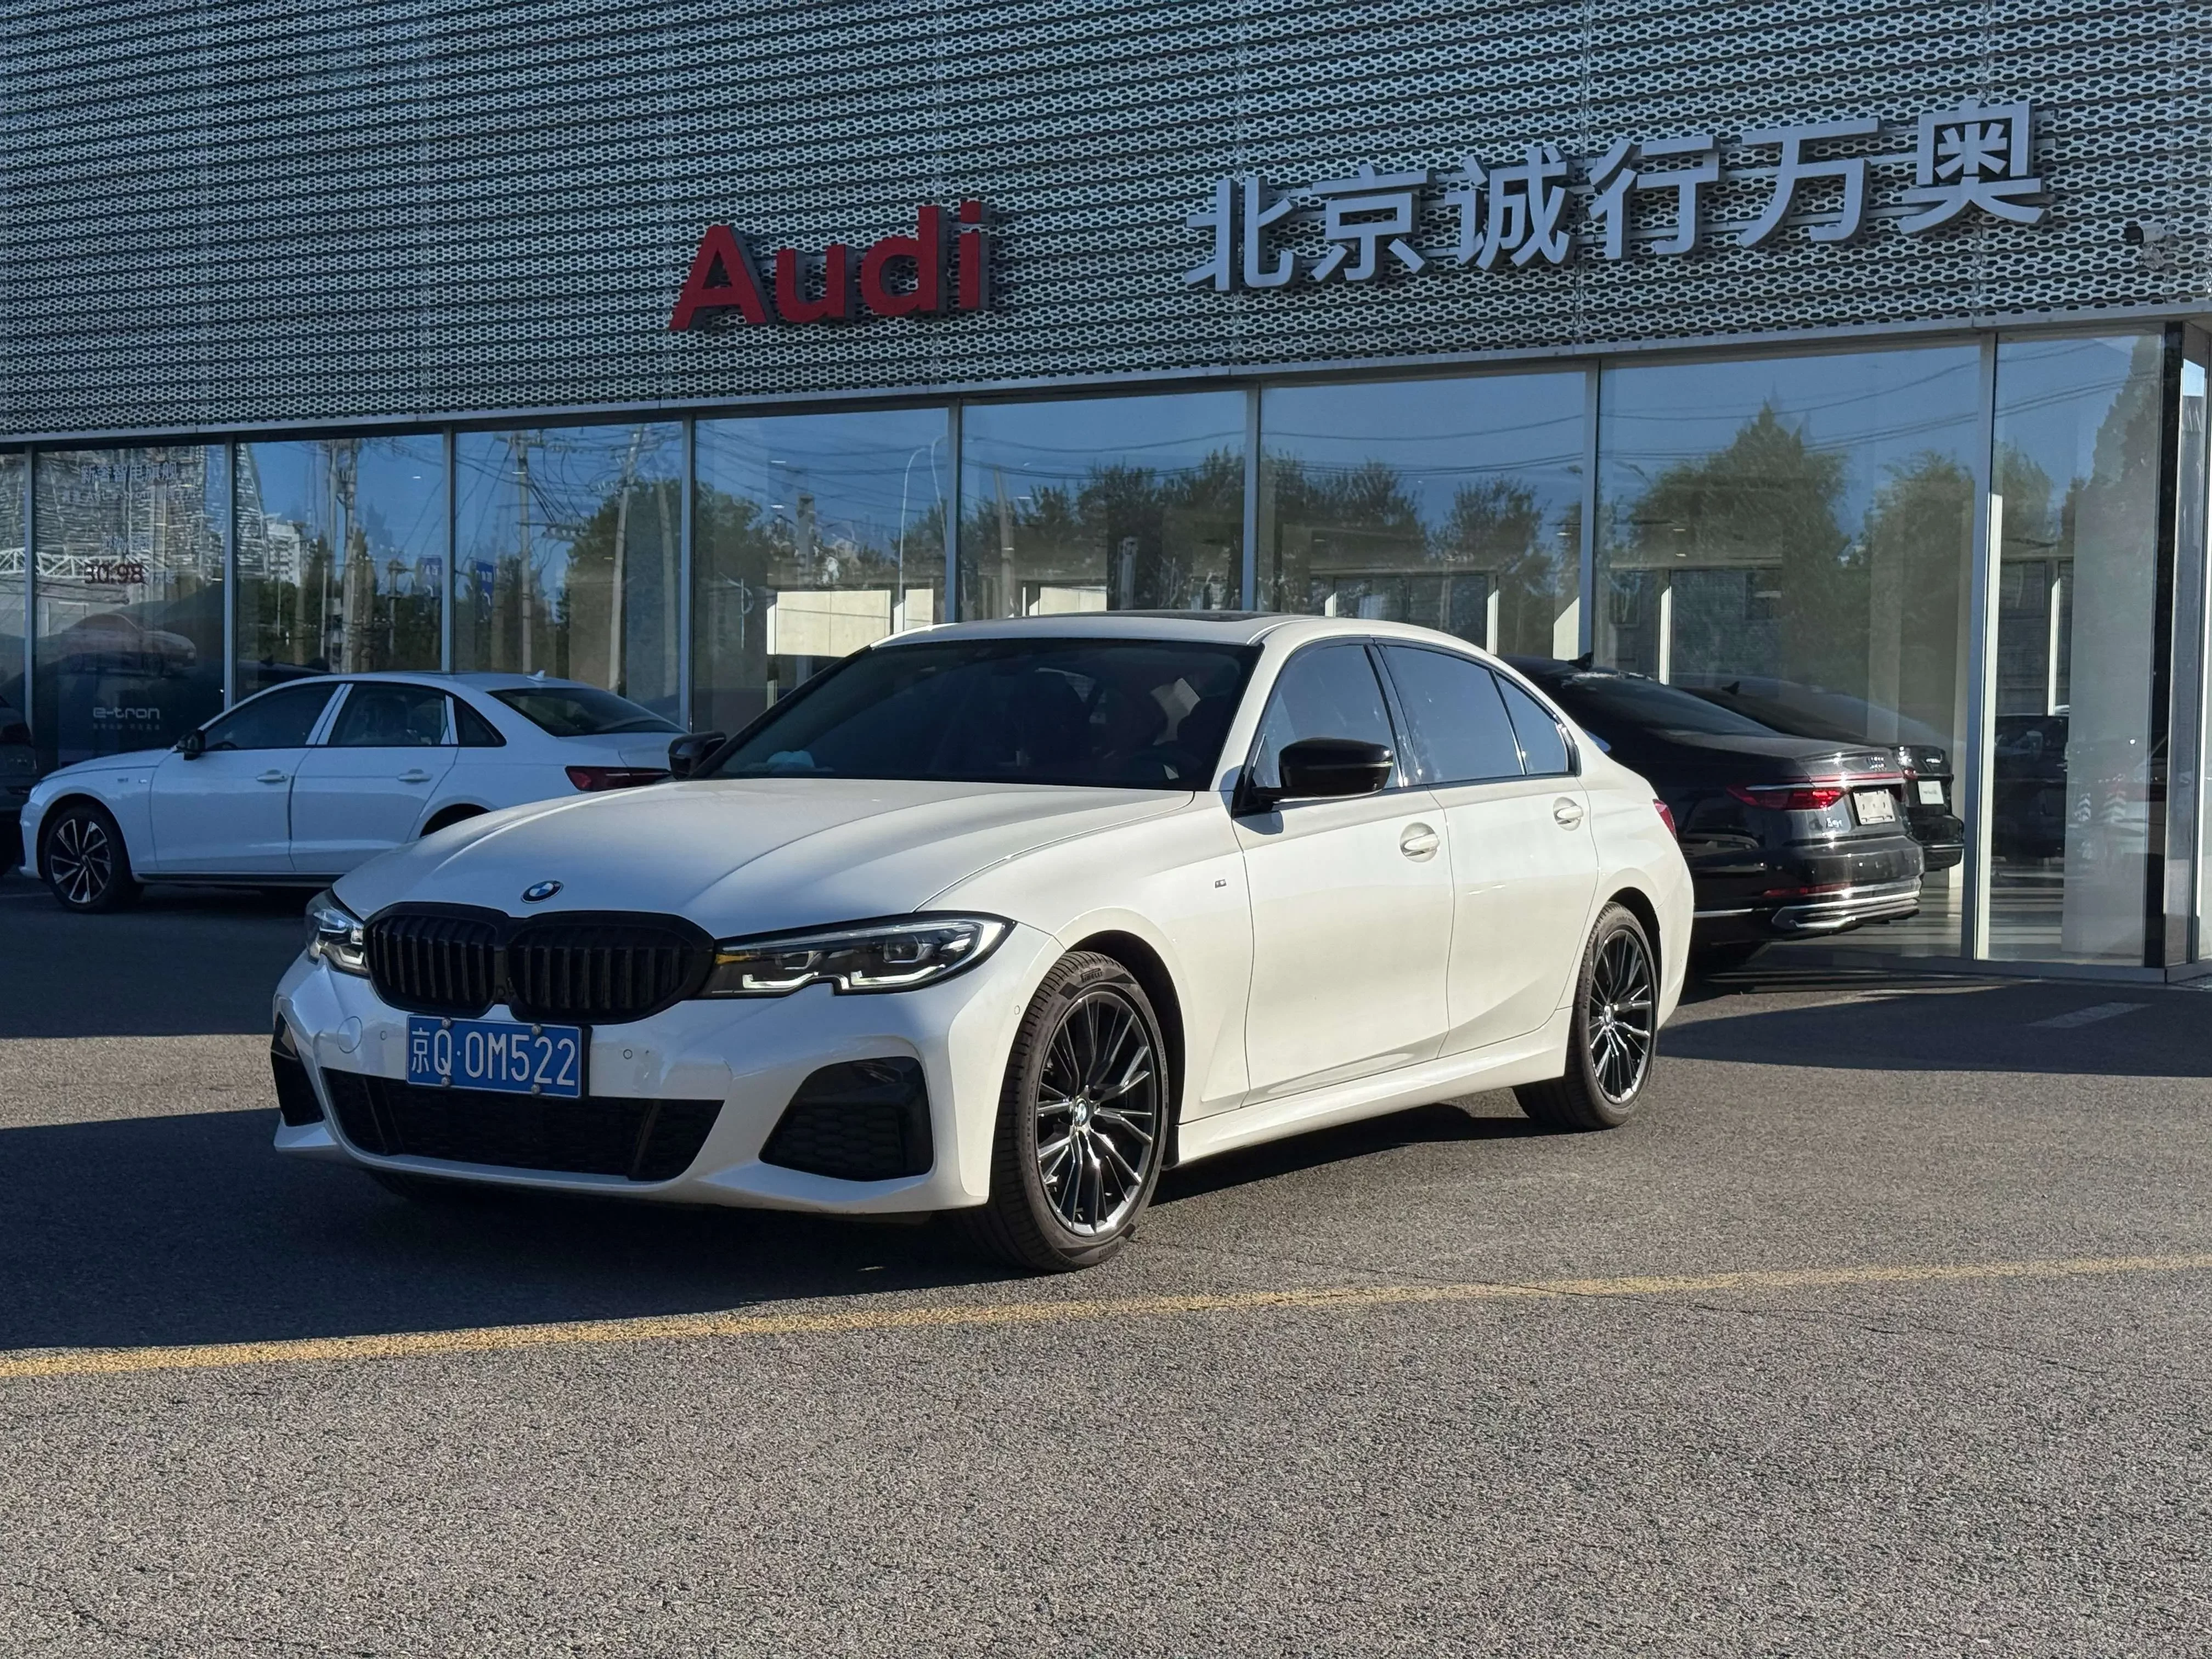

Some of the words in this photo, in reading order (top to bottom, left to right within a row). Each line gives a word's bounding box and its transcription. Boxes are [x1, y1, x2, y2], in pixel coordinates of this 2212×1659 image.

[1185, 99, 2047, 293] 北京诚行万奥
[669, 200, 989, 331] Audi
[93, 707, 160, 719] e-tron
